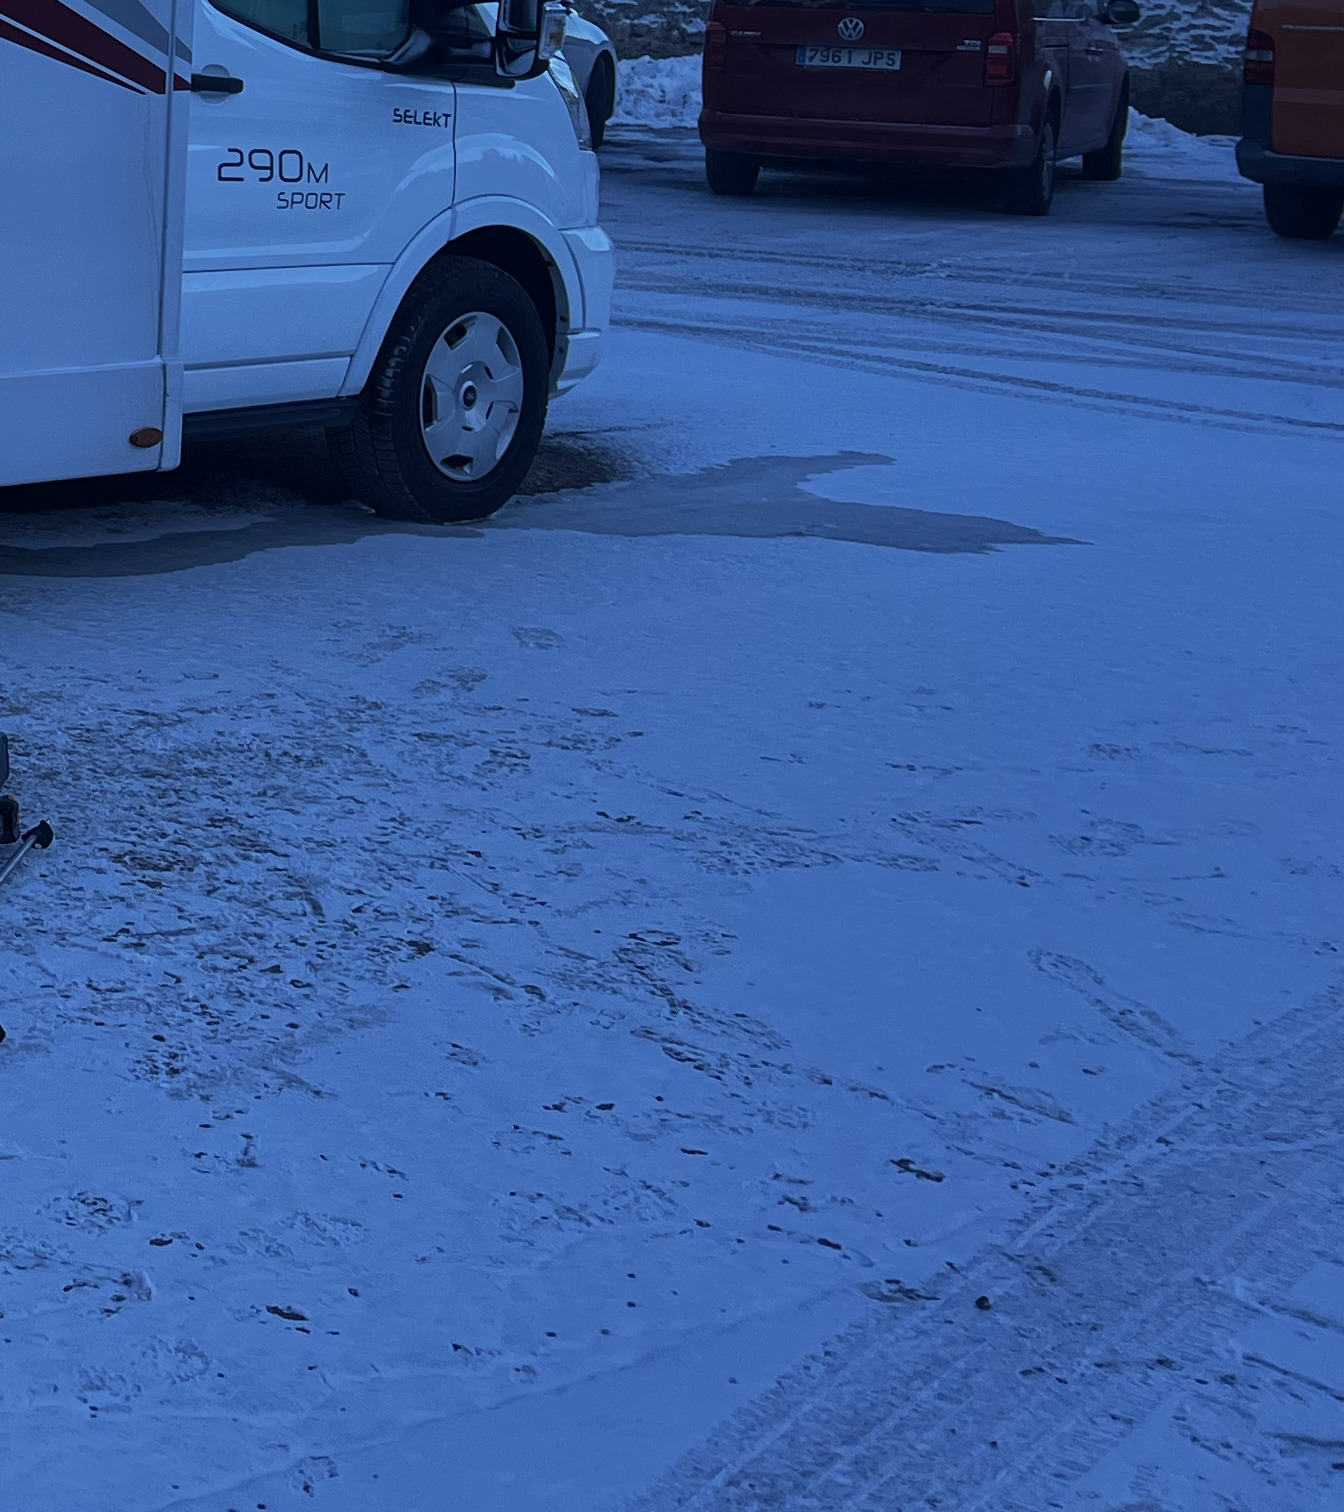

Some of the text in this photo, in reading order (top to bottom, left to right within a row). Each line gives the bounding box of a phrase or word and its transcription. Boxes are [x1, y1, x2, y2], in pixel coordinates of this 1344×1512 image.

[808, 47, 896, 67] 7961 JPS
[393, 108, 451, 128] SELEKT
[277, 192, 346, 210] SPORT
